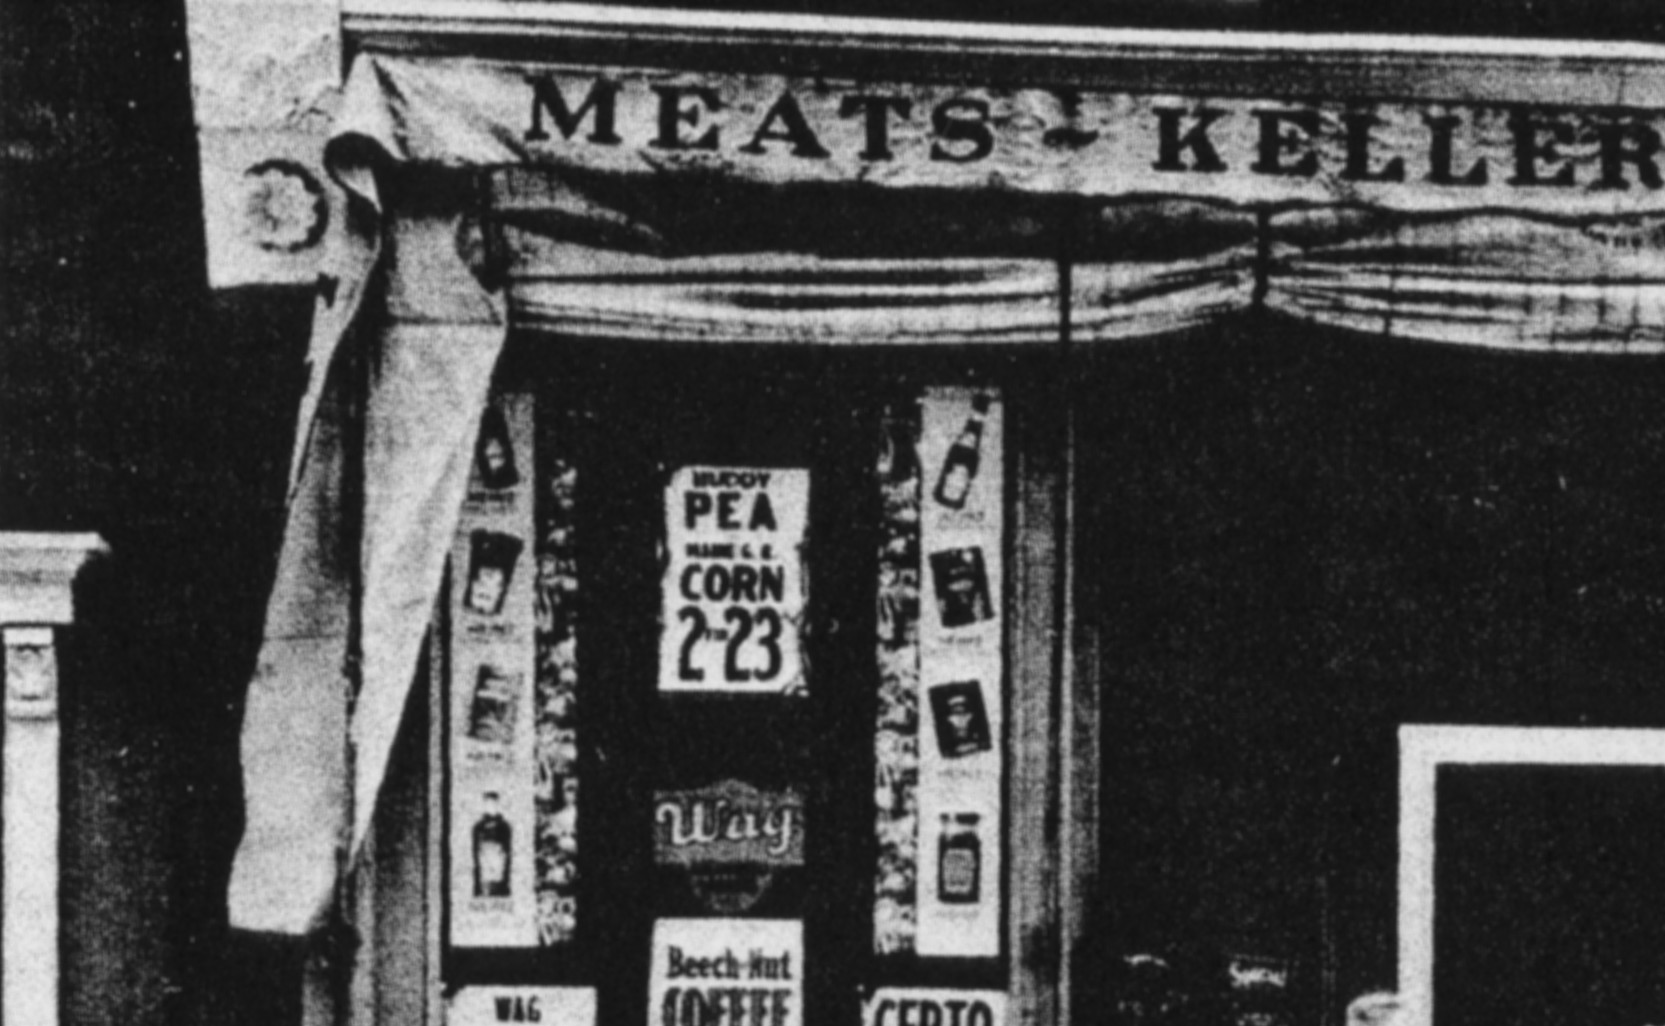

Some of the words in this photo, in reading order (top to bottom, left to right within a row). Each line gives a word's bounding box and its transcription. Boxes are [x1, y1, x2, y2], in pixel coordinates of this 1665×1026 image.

[525, 75, 995, 163] MEATS
[685, 491, 777, 531] PEA
[680, 563, 785, 603] CORN
